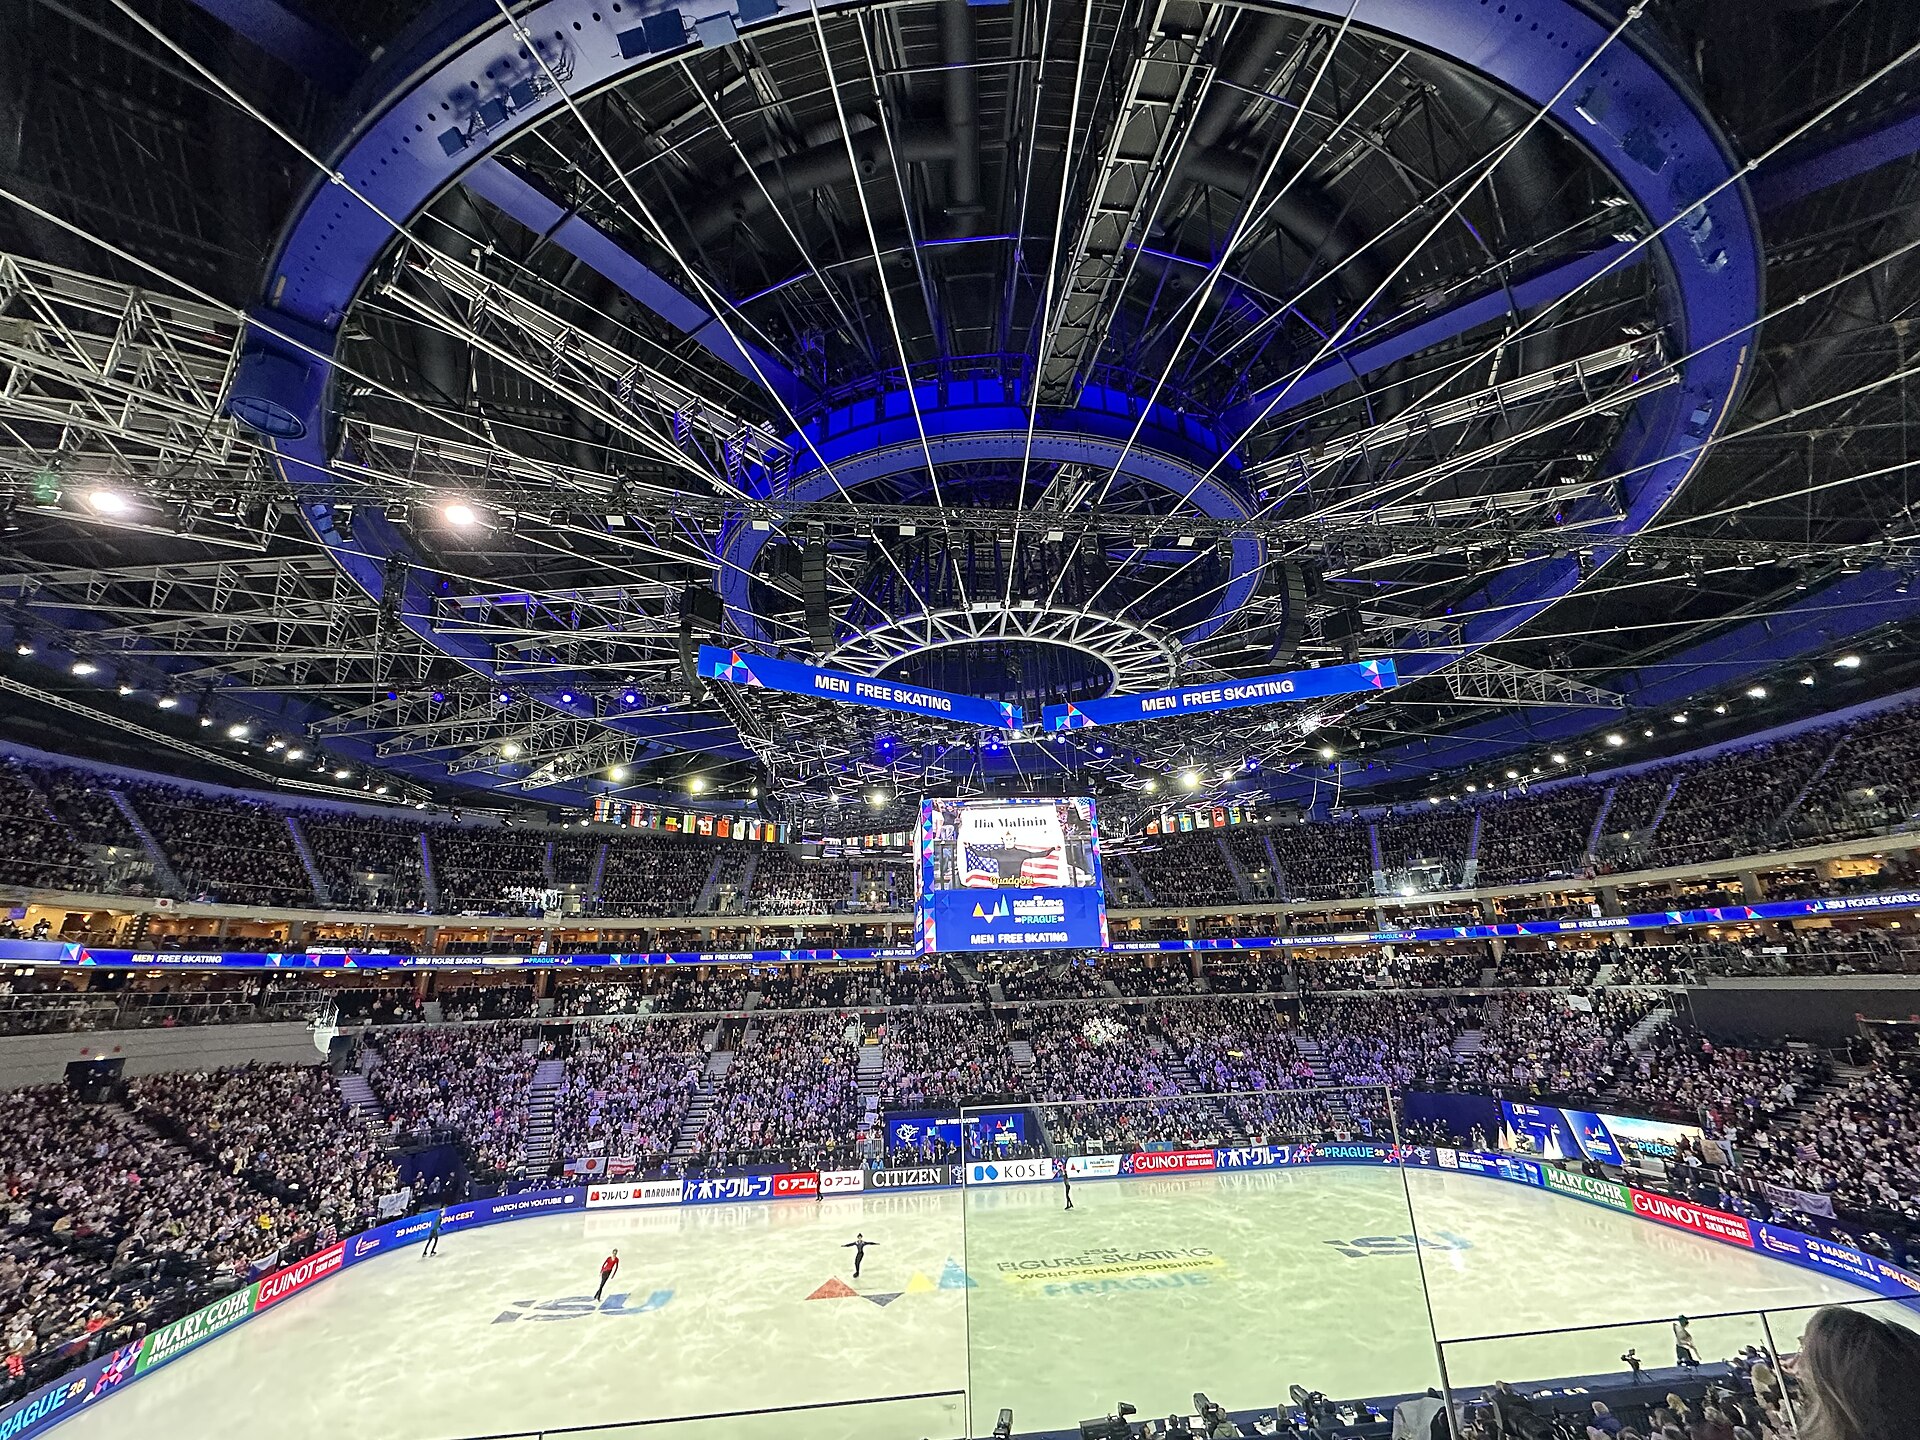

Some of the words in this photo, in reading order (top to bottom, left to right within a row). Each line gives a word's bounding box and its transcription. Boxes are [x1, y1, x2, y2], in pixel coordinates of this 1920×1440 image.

[815, 674, 849, 693] MEN
[856, 682, 892, 701] FREE
[893, 689, 952, 712] SKATING
[1141, 695, 1176, 712] MEN
[1182, 689, 1221, 707] FREE
[1223, 679, 1294, 701] SKATING
[1846, 897, 1880, 908] FIGURE
[1880, 893, 1920, 905] SKATING
[1021, 915, 1058, 924] PRAGUE
[1579, 920, 1598, 928] FREE
[1598, 918, 1630, 927] SKATING
[970, 934, 995, 945] MEN
[998, 933, 1024, 944] FREE
[1024, 932, 1068, 943] SKATING
[132, 954, 154, 963] MEN
[156, 954, 181, 963] FREE
[181, 955, 222, 963] SKATING
[1228, 1146, 1290, 1167] 木下グループ
[1324, 1146, 1375, 1158] PRAGUE
[1638, 1141, 1677, 1156] PRAG
[1004, 1161, 1046, 1178] KOSÉ
[1136, 1155, 1185, 1170] GUINOT
[698, 1177, 772, 1199] 木下グループ
[790, 1178, 817, 1189] アコム
[835, 1176, 861, 1186] アコム
[872, 1168, 942, 1188] CITIZEN
[1547, 1168, 1582, 1189] MARY
[1584, 1179, 1625, 1202] COHR
[601, 1190, 629, 1201] マルハン
[644, 1187, 681, 1198] MARUHAN
[492, 1202, 518, 1213] WATCH
[530, 1197, 562, 1207] YOUTUBE
[1610, 1198, 1627, 1208] CARE
[1634, 1194, 1702, 1227] GUINOT
[396, 1229, 406, 1238] 29
[406, 1221, 432, 1234] MARCH
[455, 1211, 475, 1221] CEST
[1702, 1213, 1745, 1229] PROFESSIONAL
[1705, 1221, 1725, 1234] SKIN
[1726, 1227, 1749, 1241] CARE
[315, 1262, 328, 1275] SKIN
[328, 1254, 342, 1268] CARE
[997, 1255, 1096, 1272] FIGURE
[1102, 1247, 1213, 1264] SKATING
[1804, 1239, 1820, 1251] 29
[1820, 1243, 1863, 1266] MARCH
[1878, 1264, 1900, 1282] 9PM
[1820, 1256, 1844, 1268] WATCH
[1844, 1263, 1854, 1272] ON
[1853, 1267, 1881, 1283] YOUTUBE
[1016, 1270, 1077, 1280] WORLD
[1082, 1260, 1214, 1275] CHAMPIONSHIPS
[260, 1260, 317, 1302] GUINOT
[1044, 1272, 1209, 1296] PRAGUE
[149, 1311, 207, 1356] MARY
[206, 1289, 251, 1326] COHR
[147, 1328, 208, 1366] PROFESSIONAL
[229, 1306, 249, 1322] CARE
[0, 1382, 71, 1440] RAGUE
[67, 1378, 87, 1399] 26
